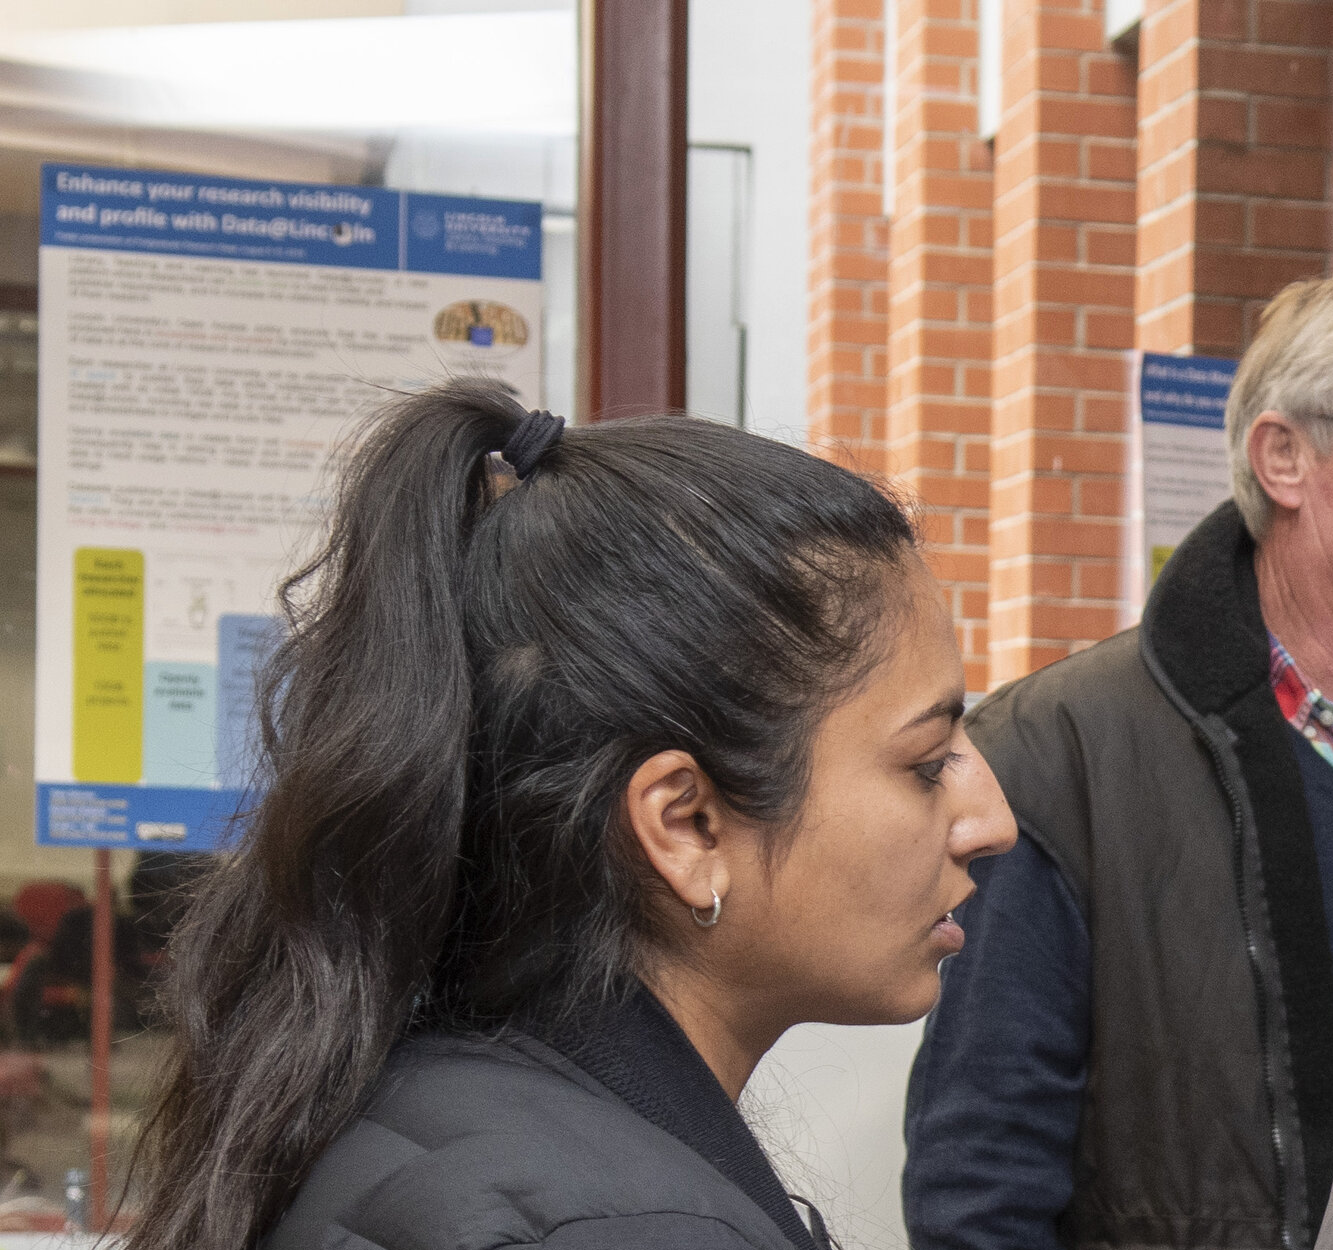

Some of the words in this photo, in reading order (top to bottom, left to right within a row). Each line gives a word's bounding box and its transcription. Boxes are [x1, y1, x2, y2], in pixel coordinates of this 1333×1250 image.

[56, 172, 143, 197] Enhance
[147, 183, 195, 203] your
[198, 185, 284, 206] research
[288, 191, 372, 217] visibility
[56, 202, 96, 223] and
[100, 206, 167, 229] profile
[172, 211, 219, 232] with
